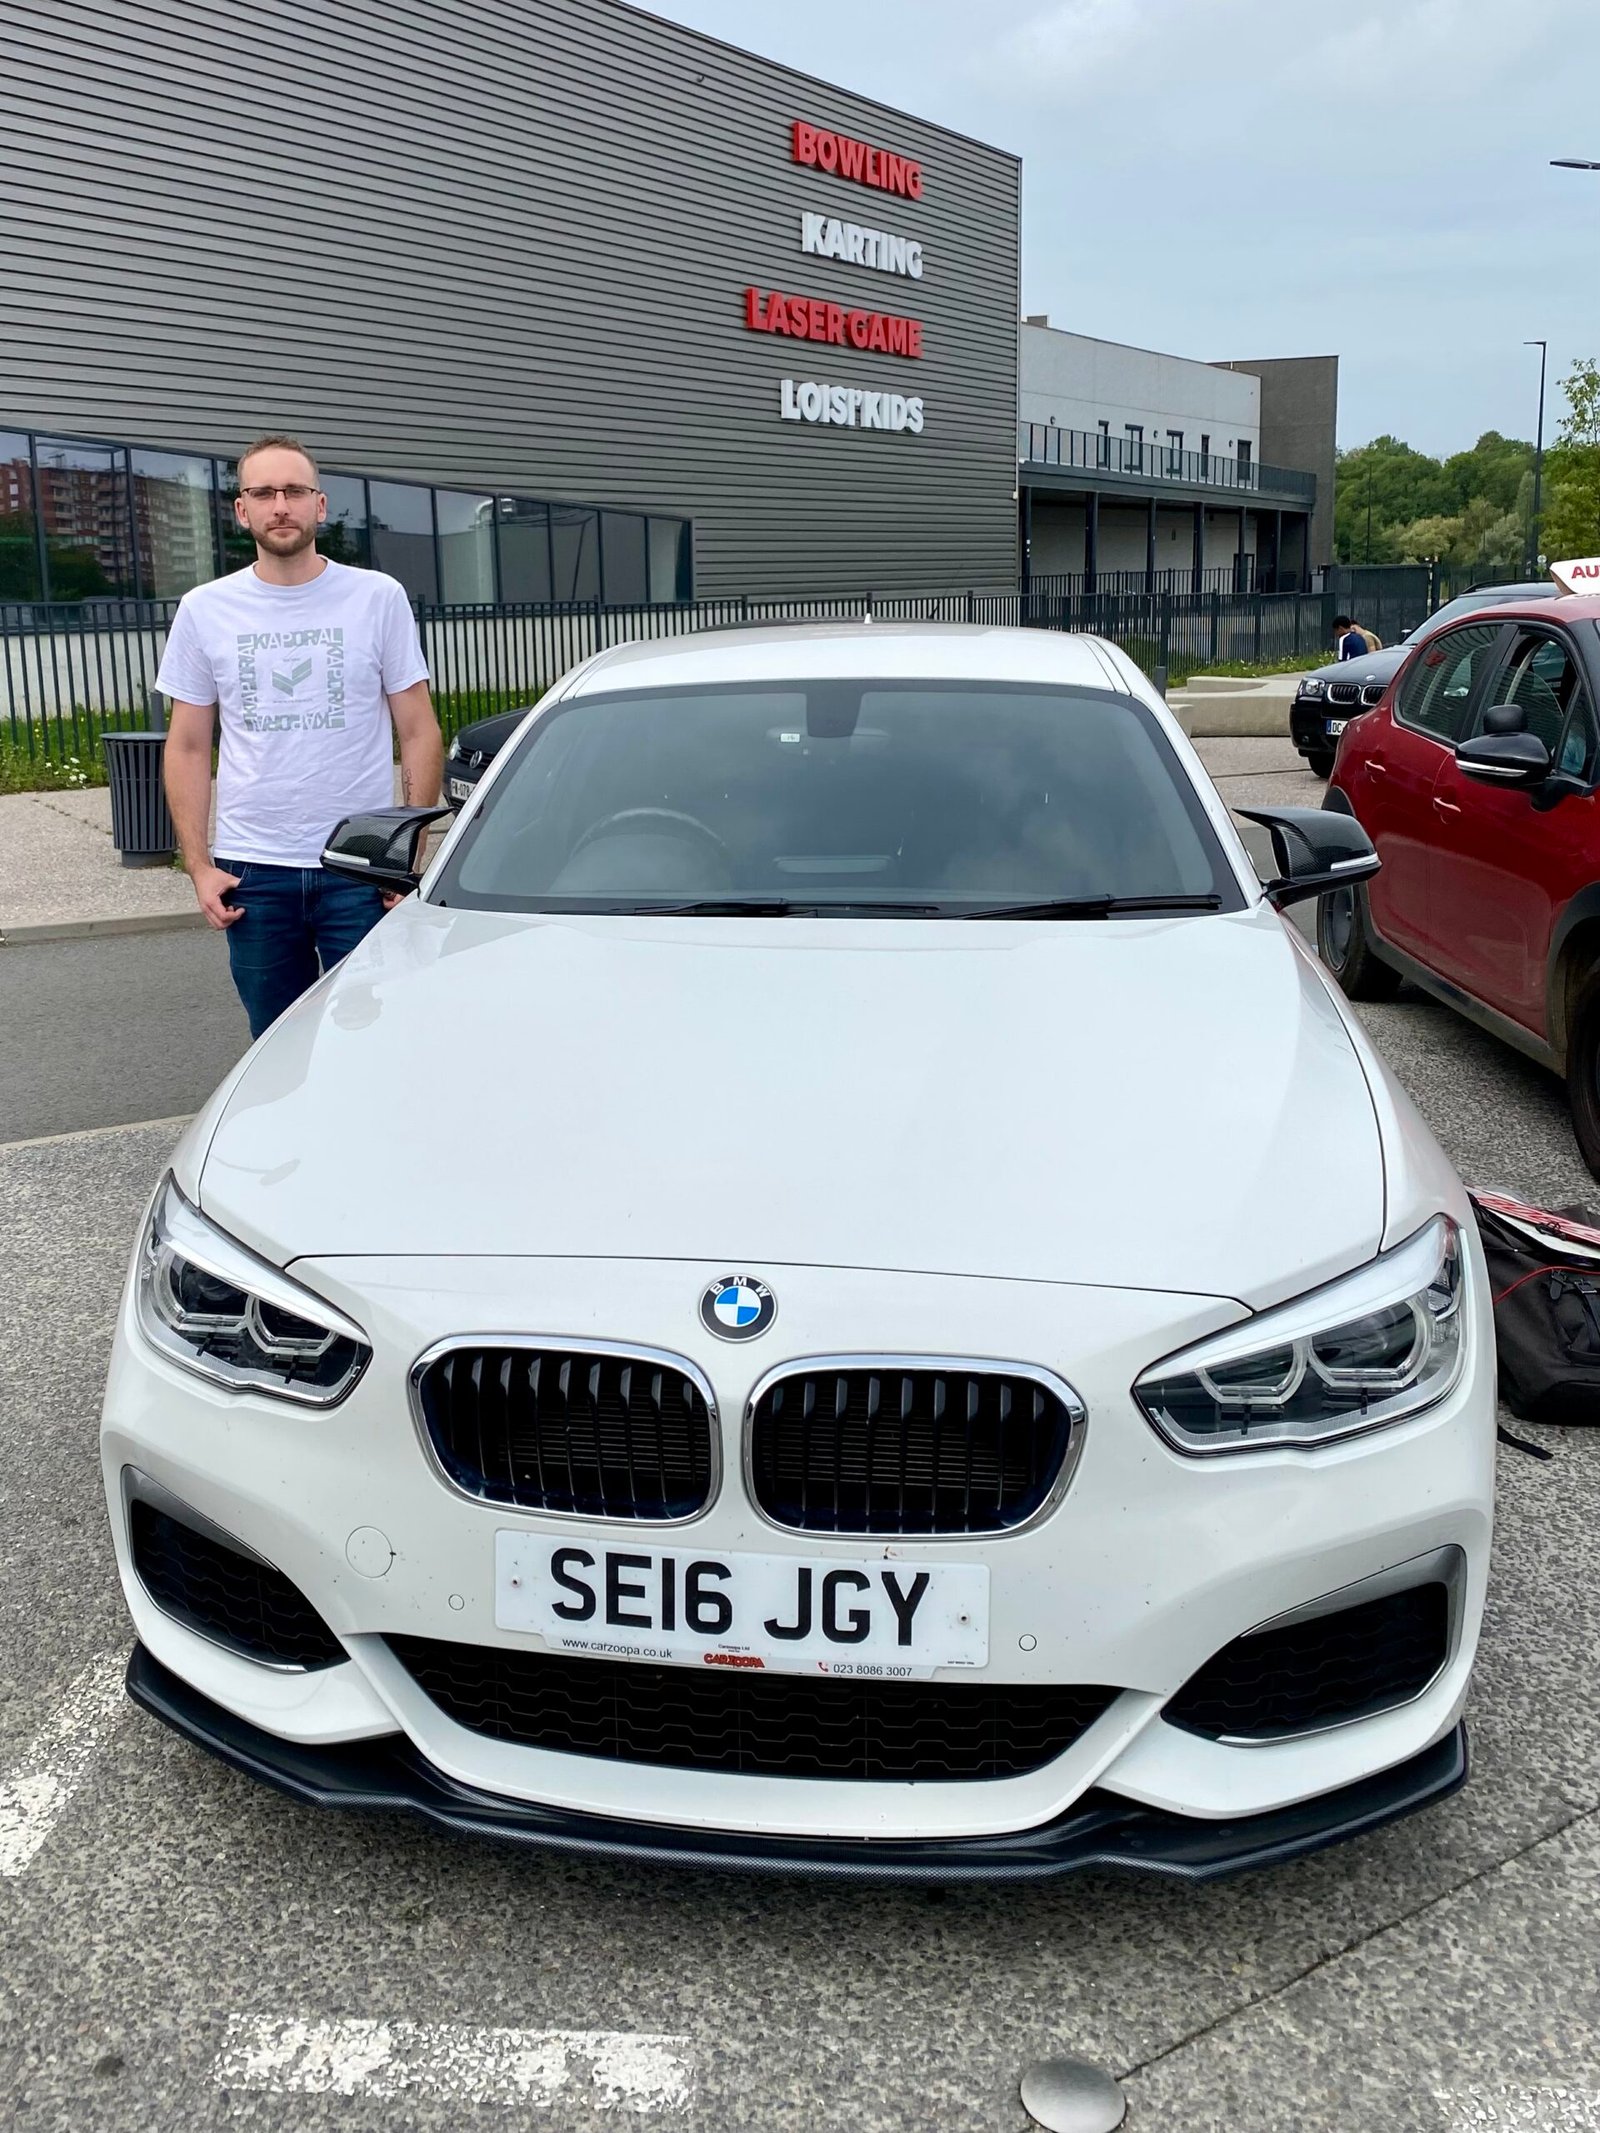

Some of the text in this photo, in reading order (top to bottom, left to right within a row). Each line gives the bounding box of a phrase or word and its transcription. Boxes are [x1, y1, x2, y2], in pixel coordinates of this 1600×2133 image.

[792, 119, 924, 200] BOWLING
[801, 211, 924, 280] KARTING
[745, 286, 925, 359] LASER GAME
[1571, 564, 1600, 579] AU
[709, 1276, 771, 1298] BMW
[551, 1547, 930, 1646] SE16 JGY
[562, 1638, 673, 1658] www.carzoopa.co.uk
[703, 1653, 765, 1668] CARZOOPA
[833, 1664, 912, 1677] 023 8086 3007
